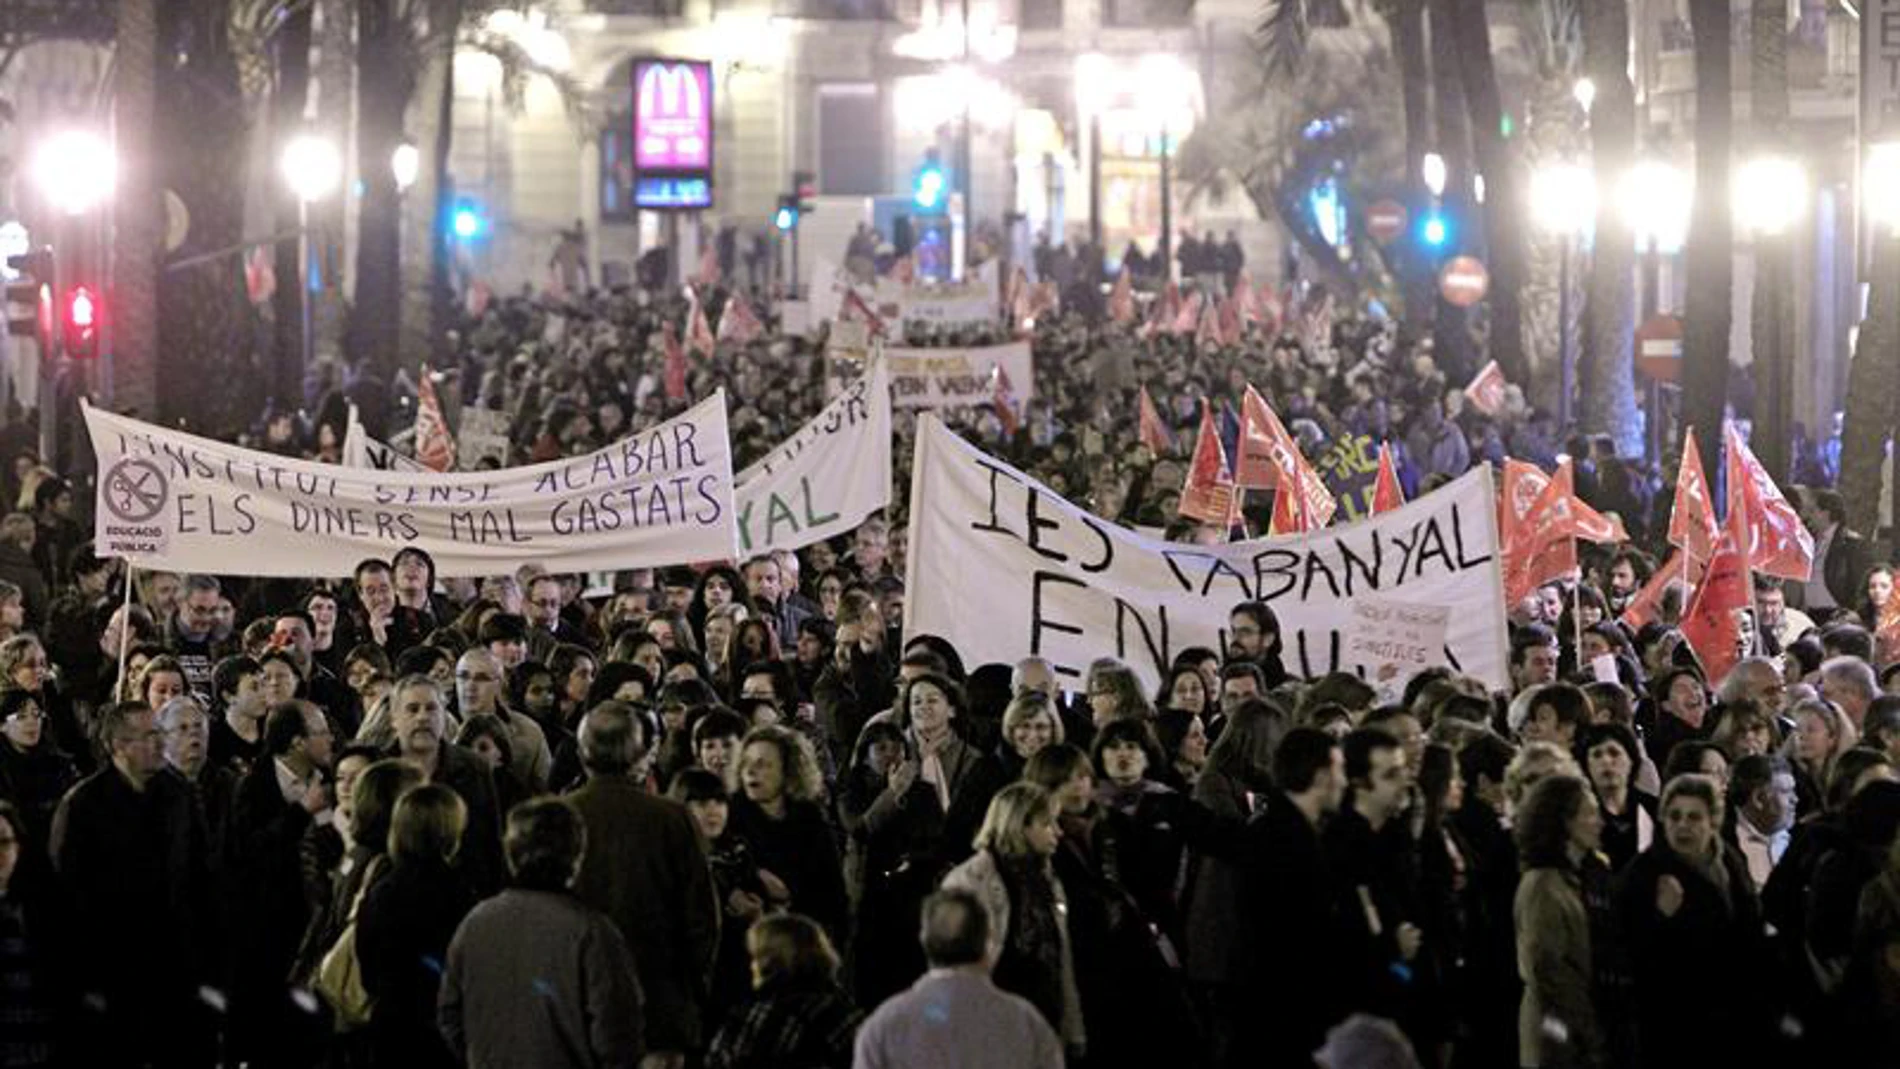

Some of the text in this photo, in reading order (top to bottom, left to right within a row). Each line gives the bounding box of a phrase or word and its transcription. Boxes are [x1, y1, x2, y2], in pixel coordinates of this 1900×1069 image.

[177, 475, 721, 543] ELS DINERS MAL GASTATS
